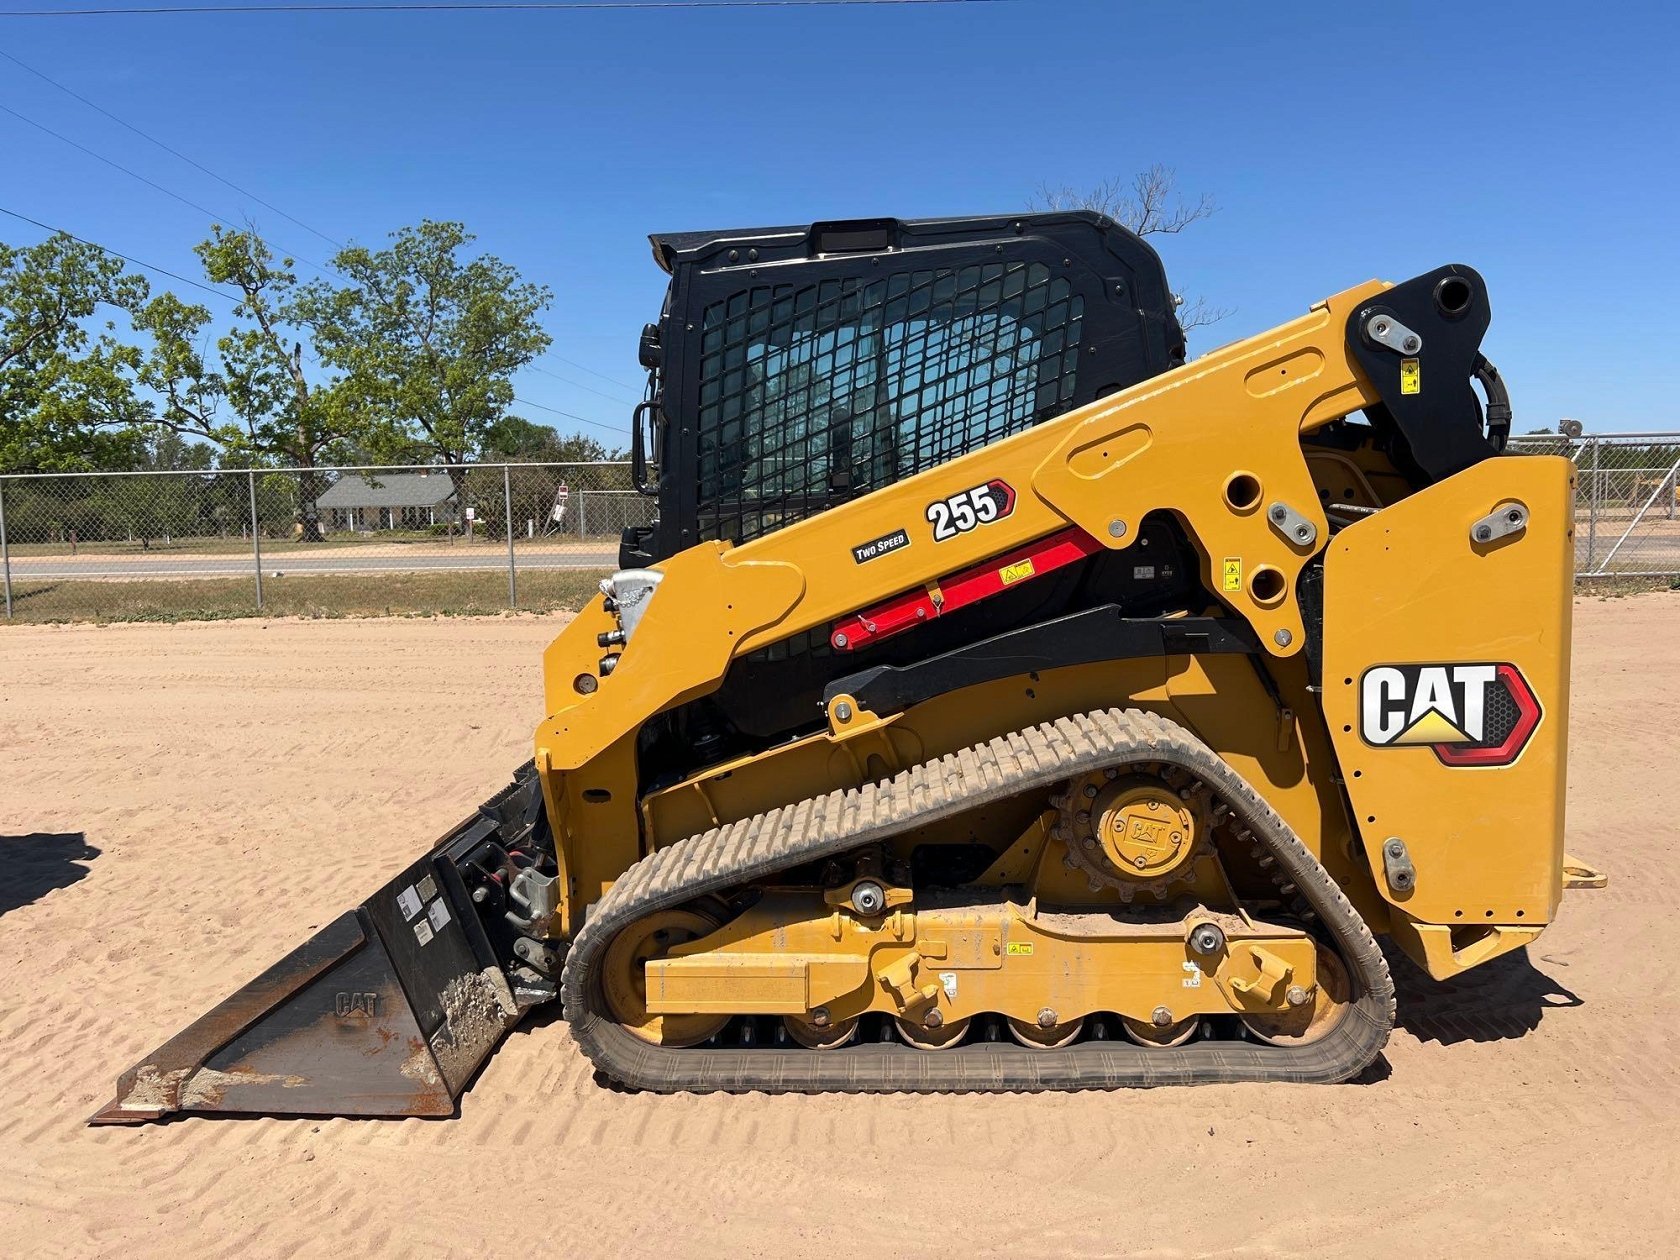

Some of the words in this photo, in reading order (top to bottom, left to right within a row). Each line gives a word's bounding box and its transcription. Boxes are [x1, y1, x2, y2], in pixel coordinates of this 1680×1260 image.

[927, 485, 997, 540] 255
[1362, 665, 1496, 744] CAT
[1131, 821, 1166, 843] CAT
[335, 991, 377, 1018] CAT
